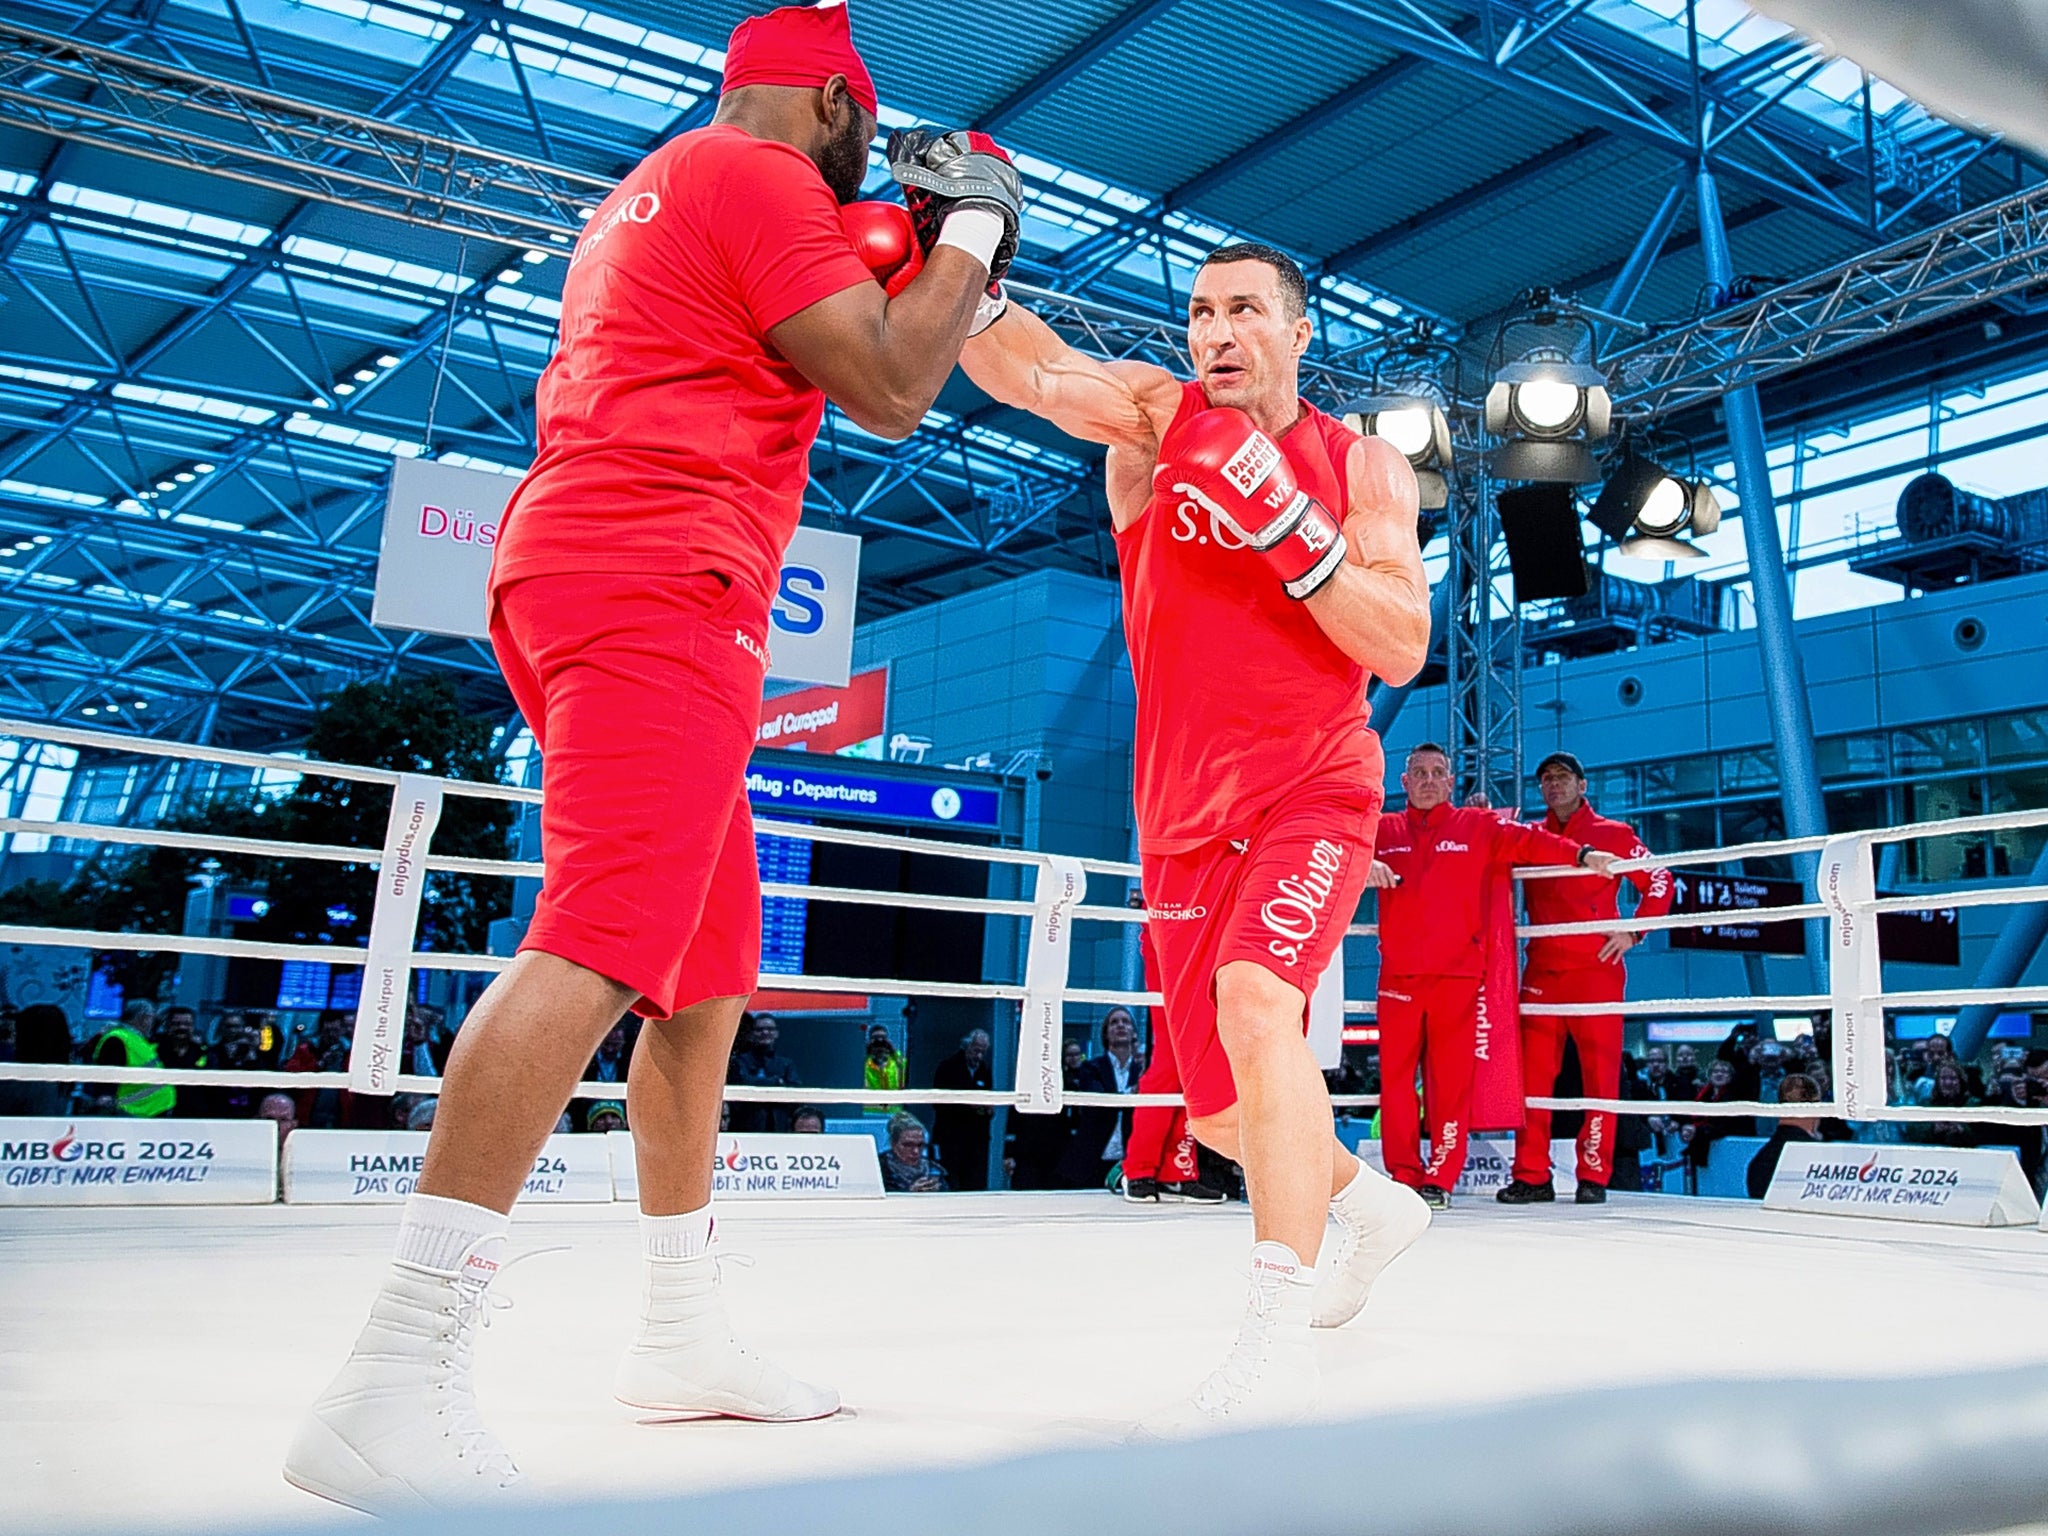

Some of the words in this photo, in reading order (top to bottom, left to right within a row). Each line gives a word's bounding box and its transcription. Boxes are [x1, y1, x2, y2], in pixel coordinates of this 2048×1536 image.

[1227, 434, 1266, 478] PAFFEN
[1239, 445, 1276, 490] SPORT
[1263, 478, 1293, 509] WK
[793, 779, 878, 804] Departures
[392, 800, 425, 896] enjoydus.com
[1261, 839, 1344, 967] s.Oliver
[377, 969, 394, 1013] Airport
[374, 1014, 388, 1038] the
[1041, 1002, 1053, 1040] Airport
[1845, 1012, 1855, 1054] Airport
[1042, 1041, 1051, 1062] the
[1846, 1057, 1855, 1077] the
[137, 1142, 215, 1160] 2024
[786, 1155, 841, 1170] 2024
[6, 1165, 67, 1187] GIBT'S
[72, 1165, 116, 1185] NUR
[122, 1163, 208, 1184] EINMAL!
[353, 1176, 388, 1195] DAS
[746, 1175, 777, 1191] NUR
[782, 1175, 839, 1190] EINMAL!
[1907, 1168, 1959, 1187] 2024
[1800, 1182, 1825, 1200] DAS
[1862, 1187, 1893, 1205] NUR
[1893, 1188, 1951, 1207] EINMAL!
